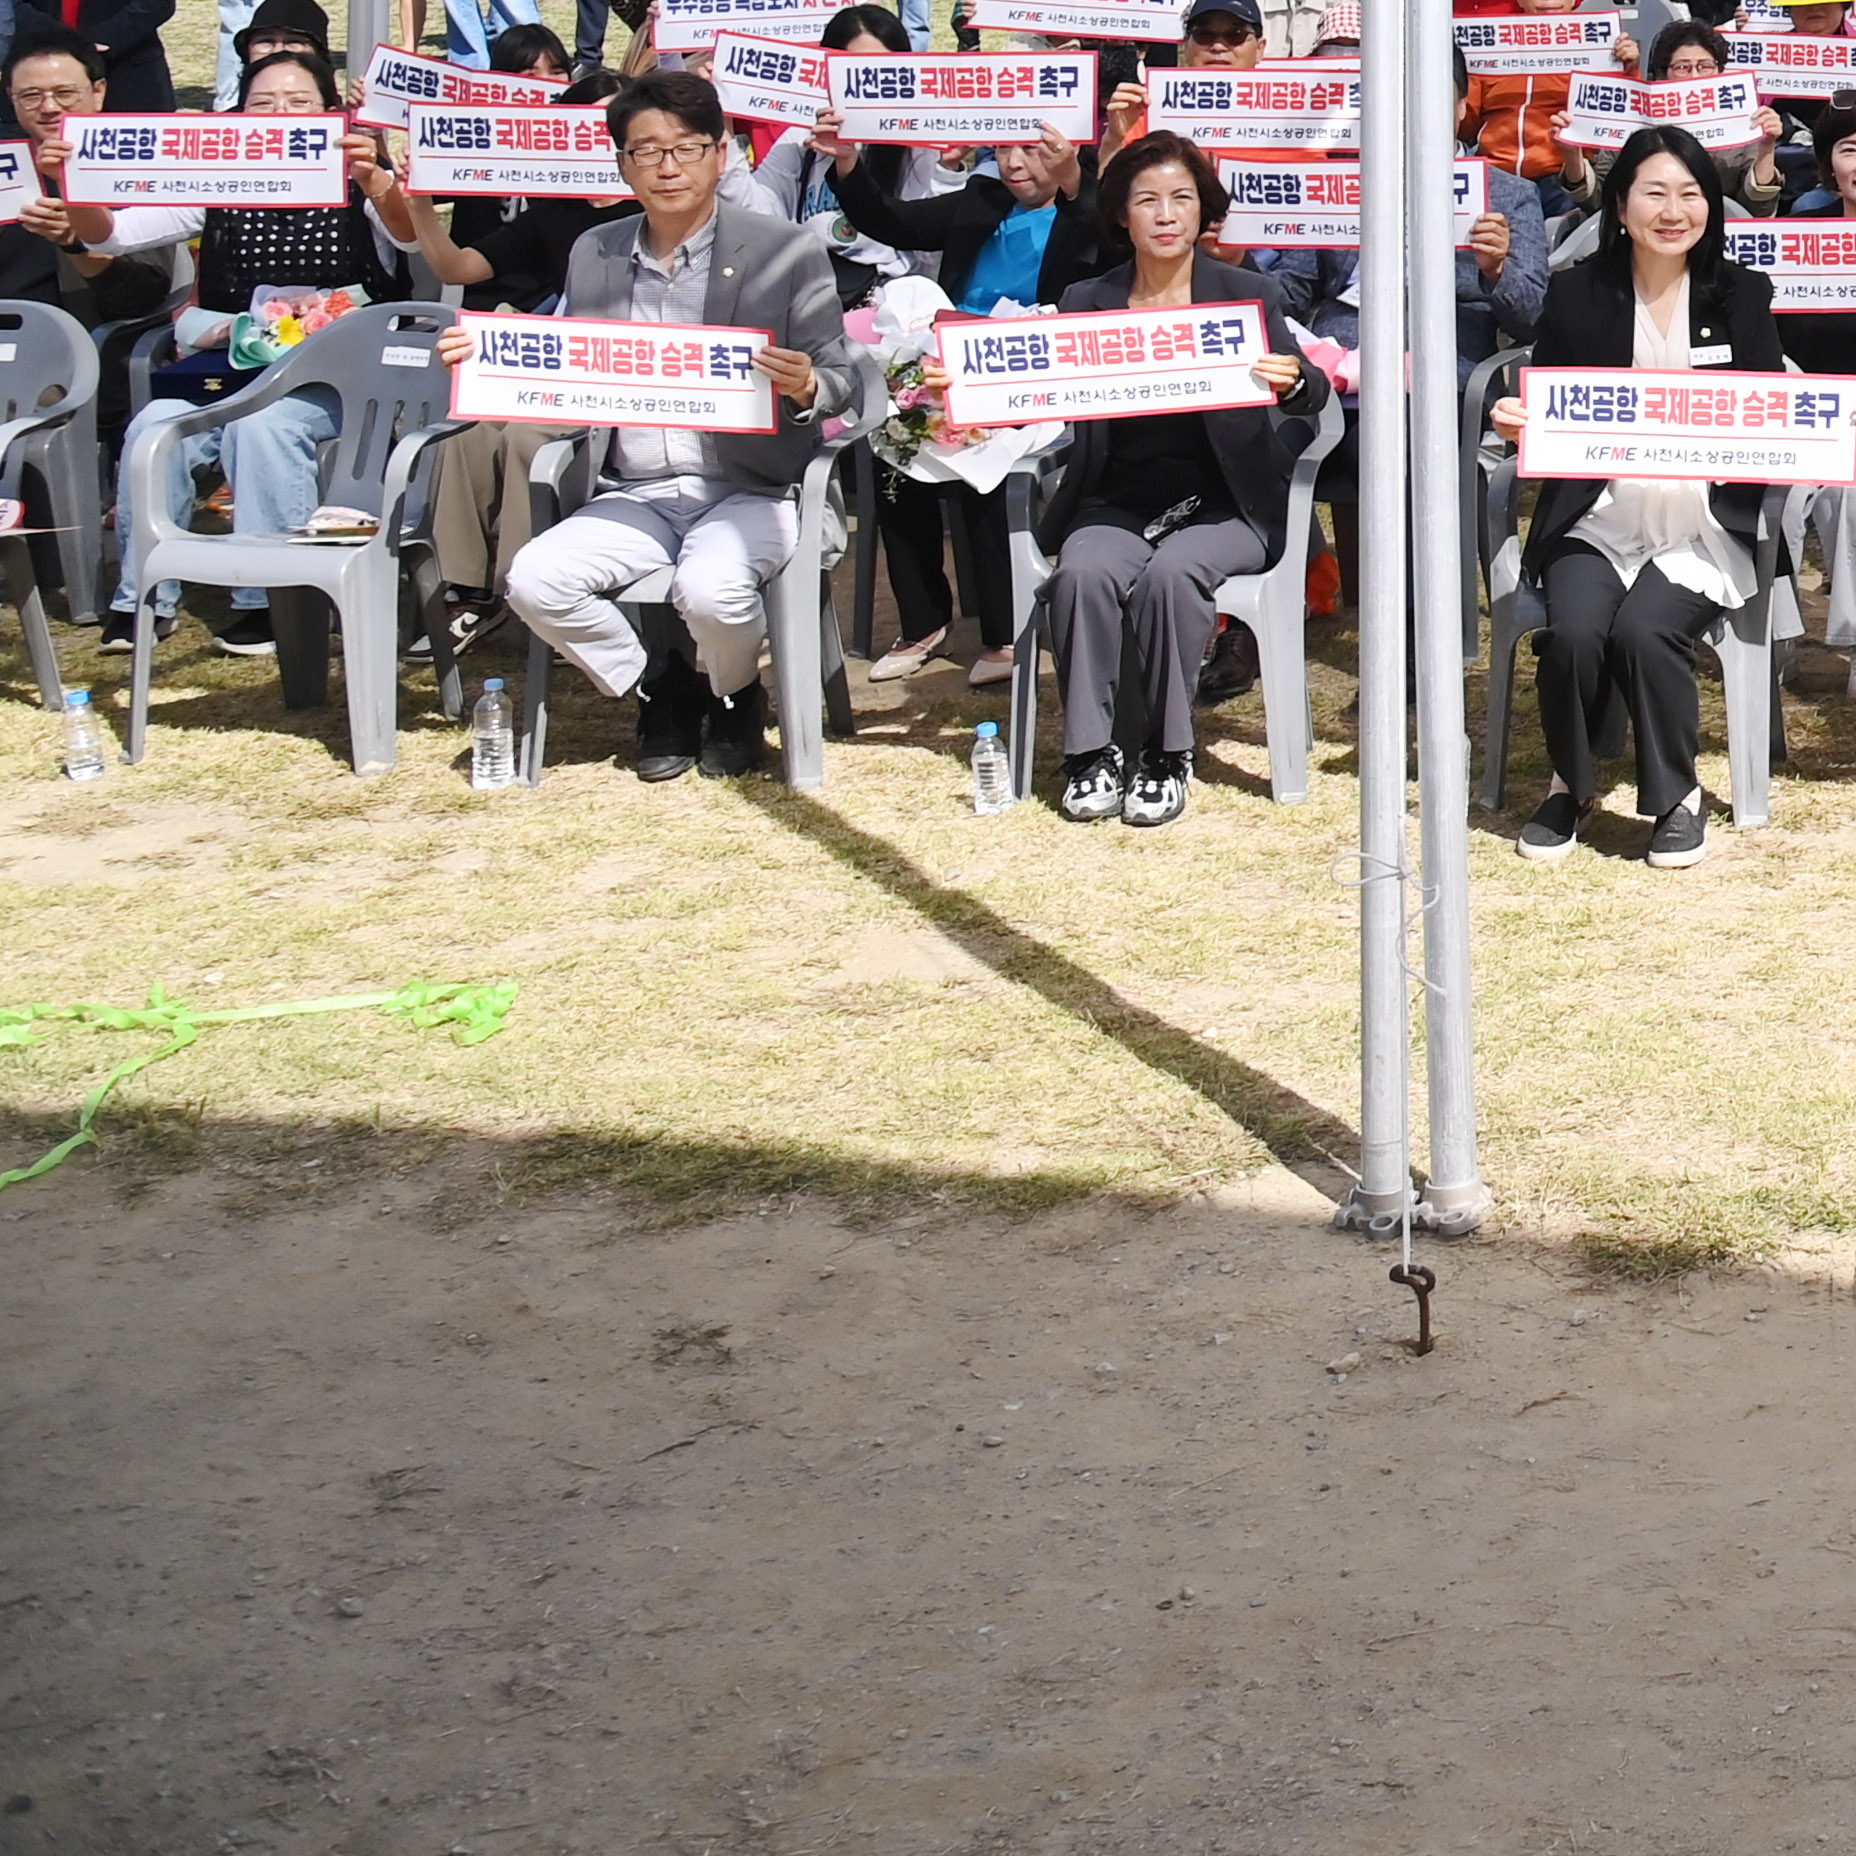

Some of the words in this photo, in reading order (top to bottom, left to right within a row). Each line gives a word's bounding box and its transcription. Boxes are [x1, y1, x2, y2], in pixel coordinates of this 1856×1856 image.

[845, 67, 915, 98] 사천공항
[921, 67, 992, 98] 국제공항
[997, 67, 1034, 98] 승격
[1040, 66, 1078, 97] 촉구
[480, 330, 562, 369] 사천공항
[569, 336, 655, 375] 국제공항
[661, 342, 704, 378] 승격
[710, 344, 754, 380] 촉구
[963, 334, 1049, 374] 사천공항
[1055, 327, 1145, 367] 국제공항
[1151, 323, 1196, 360] 승격
[1200, 319, 1245, 355] 촉구
[518, 391, 564, 406] KFME
[571, 395, 721, 413] 사천시소상공인연합회
[1009, 393, 1056, 408] KFME
[1059, 379, 1216, 406] 사천시소상공인연합회
[1546, 384, 1638, 422] 사천공항
[1645, 388, 1737, 426] 국제공항
[1743, 391, 1788, 427] 승격
[1795, 392, 1839, 428] 촉구
[1586, 447, 1637, 461] KFME
[1644, 448, 1796, 465] 사천시소상공인연합회
